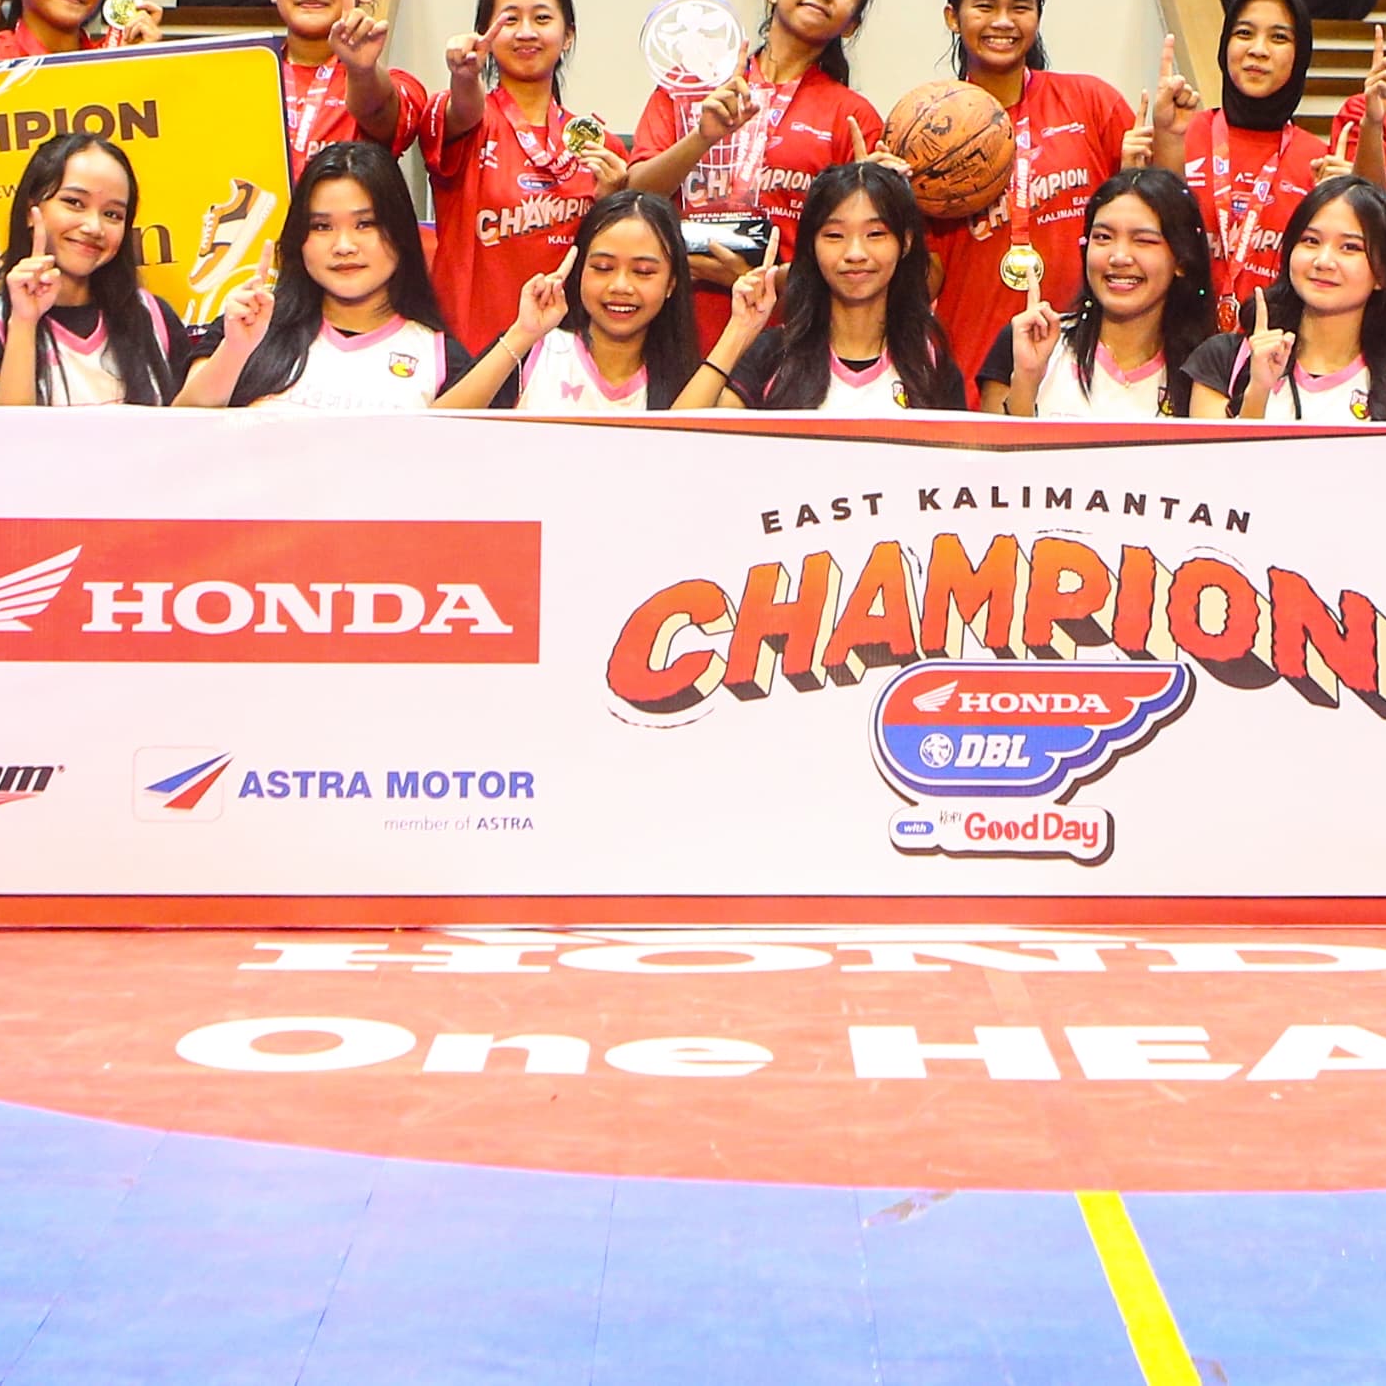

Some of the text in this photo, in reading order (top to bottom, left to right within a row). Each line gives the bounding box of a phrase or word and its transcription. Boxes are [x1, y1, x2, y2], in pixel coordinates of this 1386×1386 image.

[684, 165, 812, 208] CHMPION
[969, 167, 1088, 242] HMPION
[475, 194, 593, 247] CHAMPIO
[1036, 206, 1086, 226] KALIMANT
[761, 485, 1251, 534] EAST KALIMANTAN
[82, 581, 513, 634] HONDA
[957, 690, 1113, 716] HONDA
[954, 734, 1031, 768] DBL
[238, 770, 534, 799] ASTRA MOTOR
[385, 815, 533, 830] member of ASTRA
[903, 821, 927, 833] with
[175, 1017, 778, 1080] One
